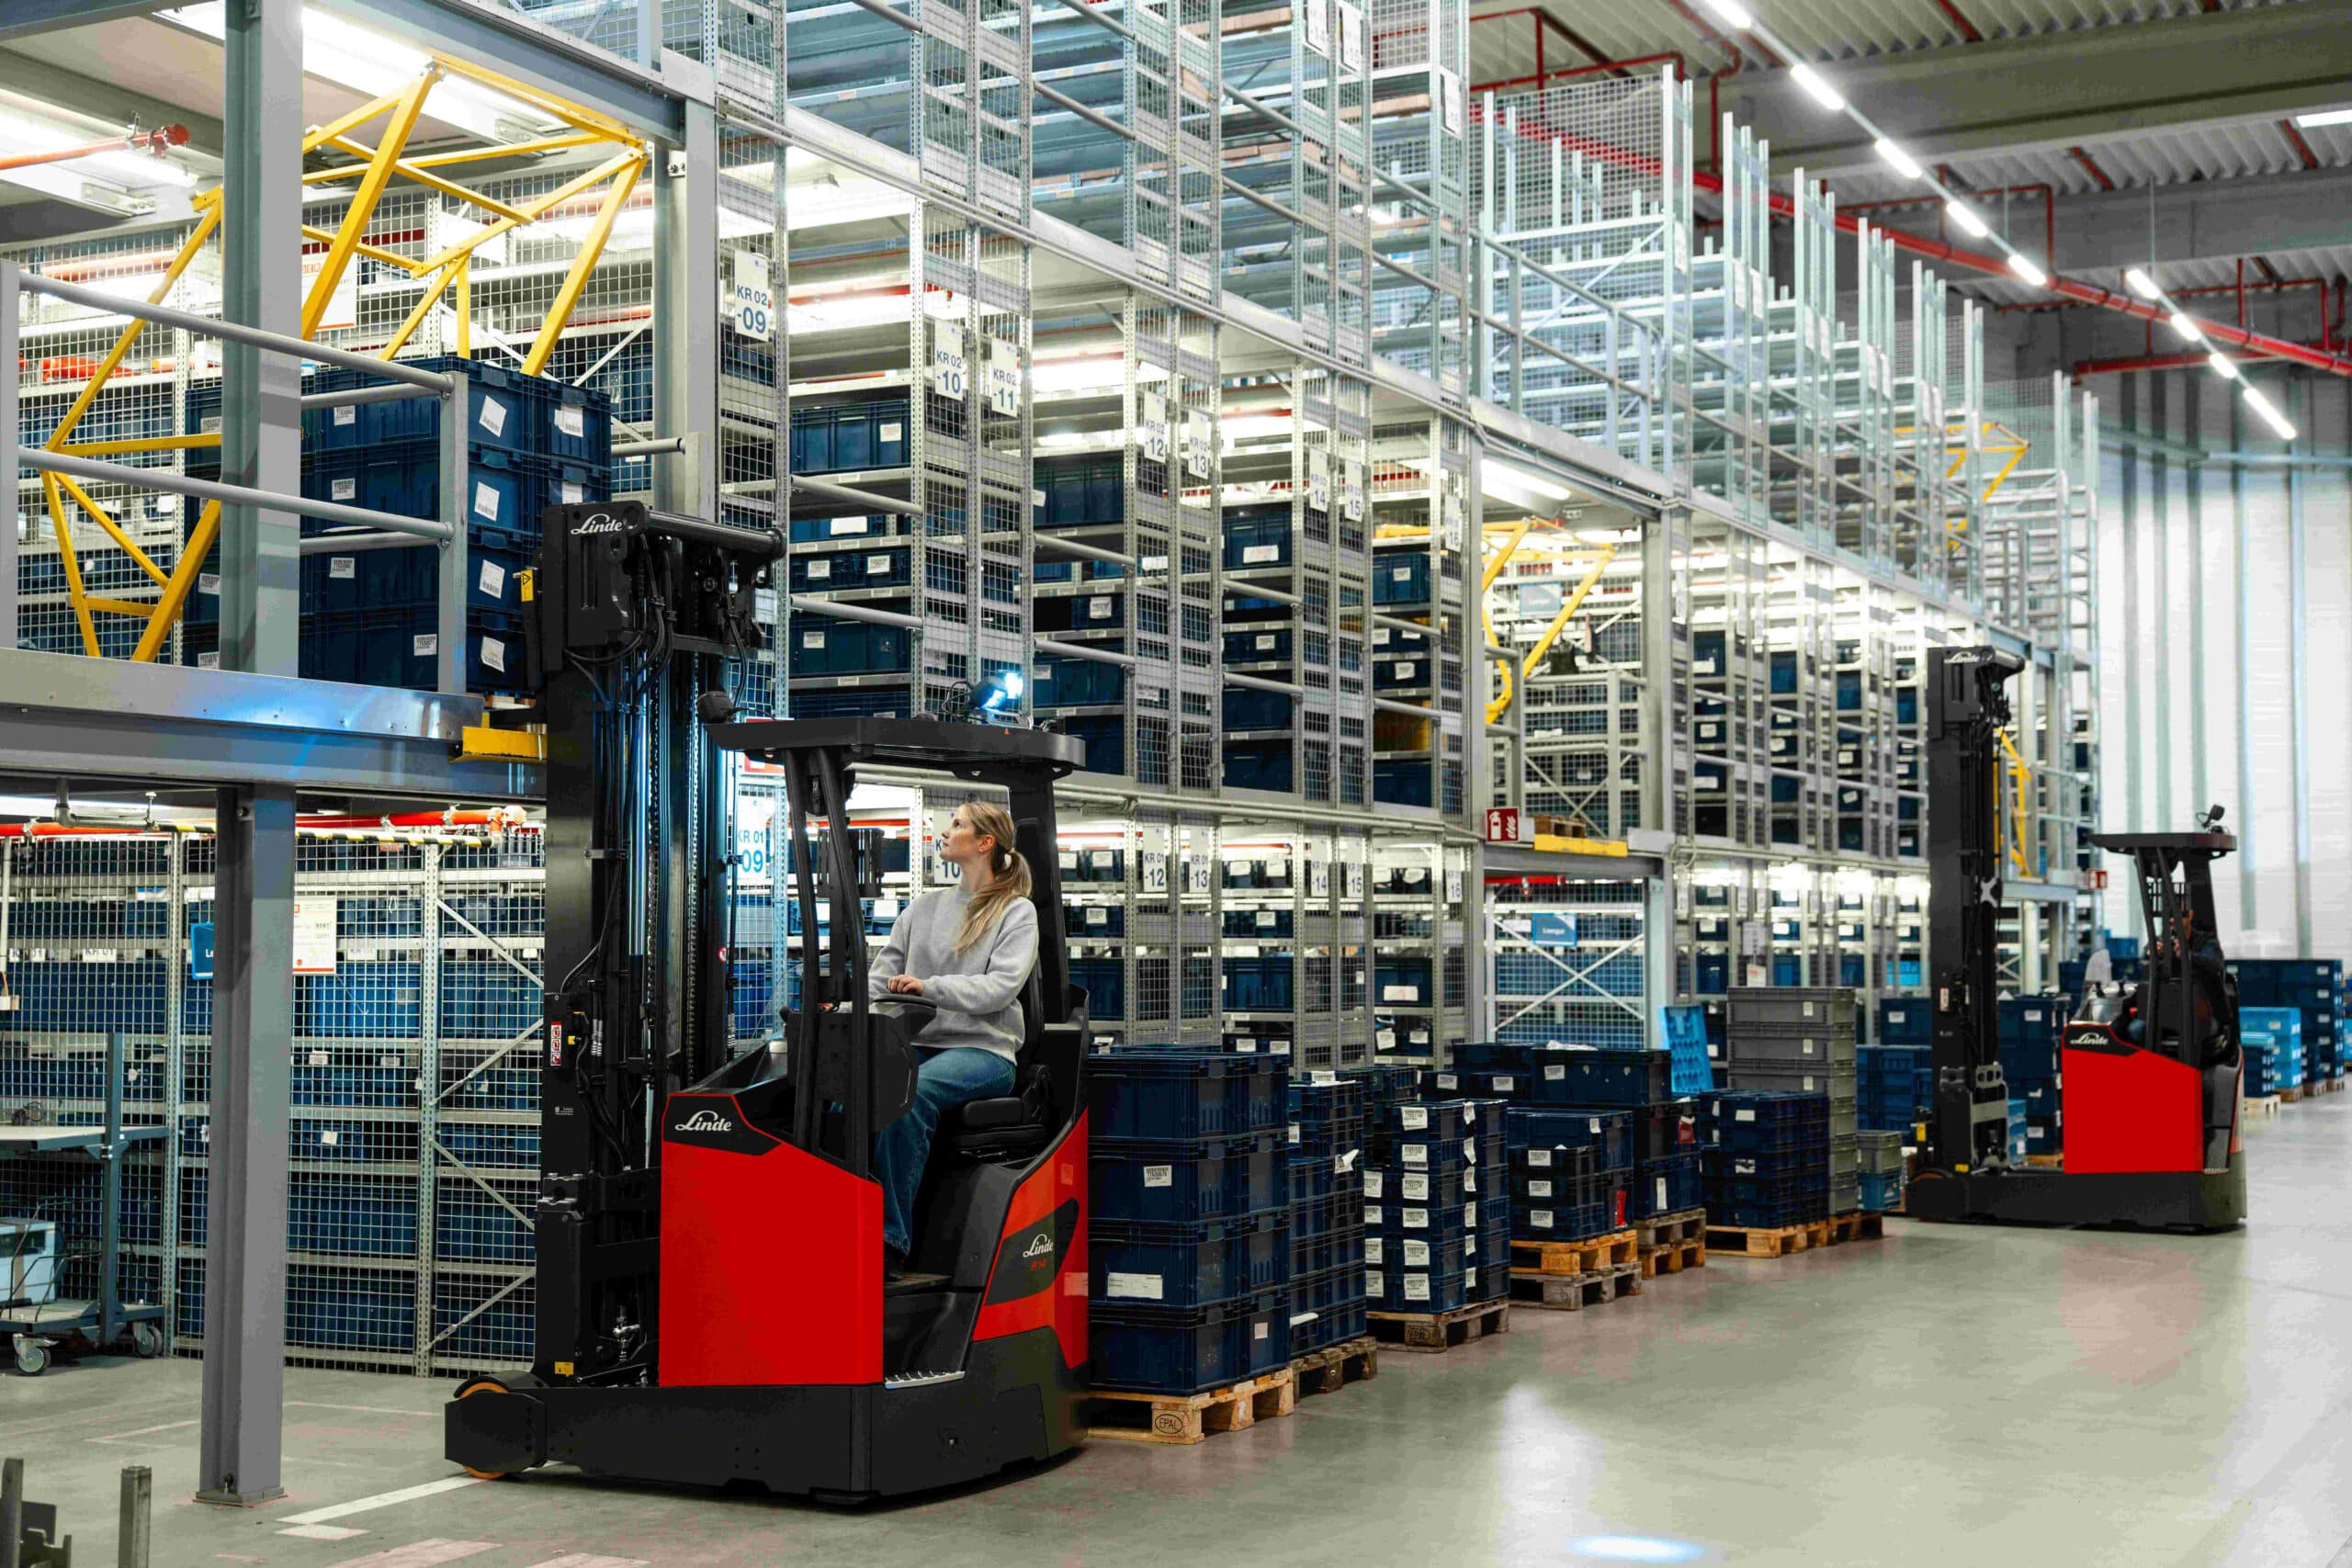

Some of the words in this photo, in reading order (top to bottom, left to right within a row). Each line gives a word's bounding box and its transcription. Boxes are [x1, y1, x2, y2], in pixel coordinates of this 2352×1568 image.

[737, 284, 752, 301] KR
[754, 290, 767, 306] 02
[737, 306, 766, 333] -09
[937, 350, 950, 365] KR
[951, 355, 962, 368] 02
[937, 369, 961, 394] -10
[993, 368, 1005, 382] KR
[1006, 373, 1017, 386] 02
[993, 387, 1013, 411] -11
[1145, 419, 1156, 432] KR
[1157, 422, 1165, 434] 02
[1146, 436, 1164, 457] -12
[1191, 453, 1207, 473] -13
[571, 513, 623, 535] Linde
[738, 829, 750, 843] KR
[753, 830, 763, 843] 01
[1145, 852, 1155, 863] KR
[1156, 852, 1164, 863] 01
[1191, 855, 1199, 865] KR
[1145, 868, 1164, 887] -12
[1191, 870, 1207, 888] -13
[1312, 875, 1327, 892] -14
[1348, 877, 1362, 893] -15
[2070, 1032, 2109, 1045] Linde
[674, 1110, 732, 1132] Linde
[1023, 1234, 1054, 1258] Linde
[1159, 1417, 1180, 1431] EPAL
